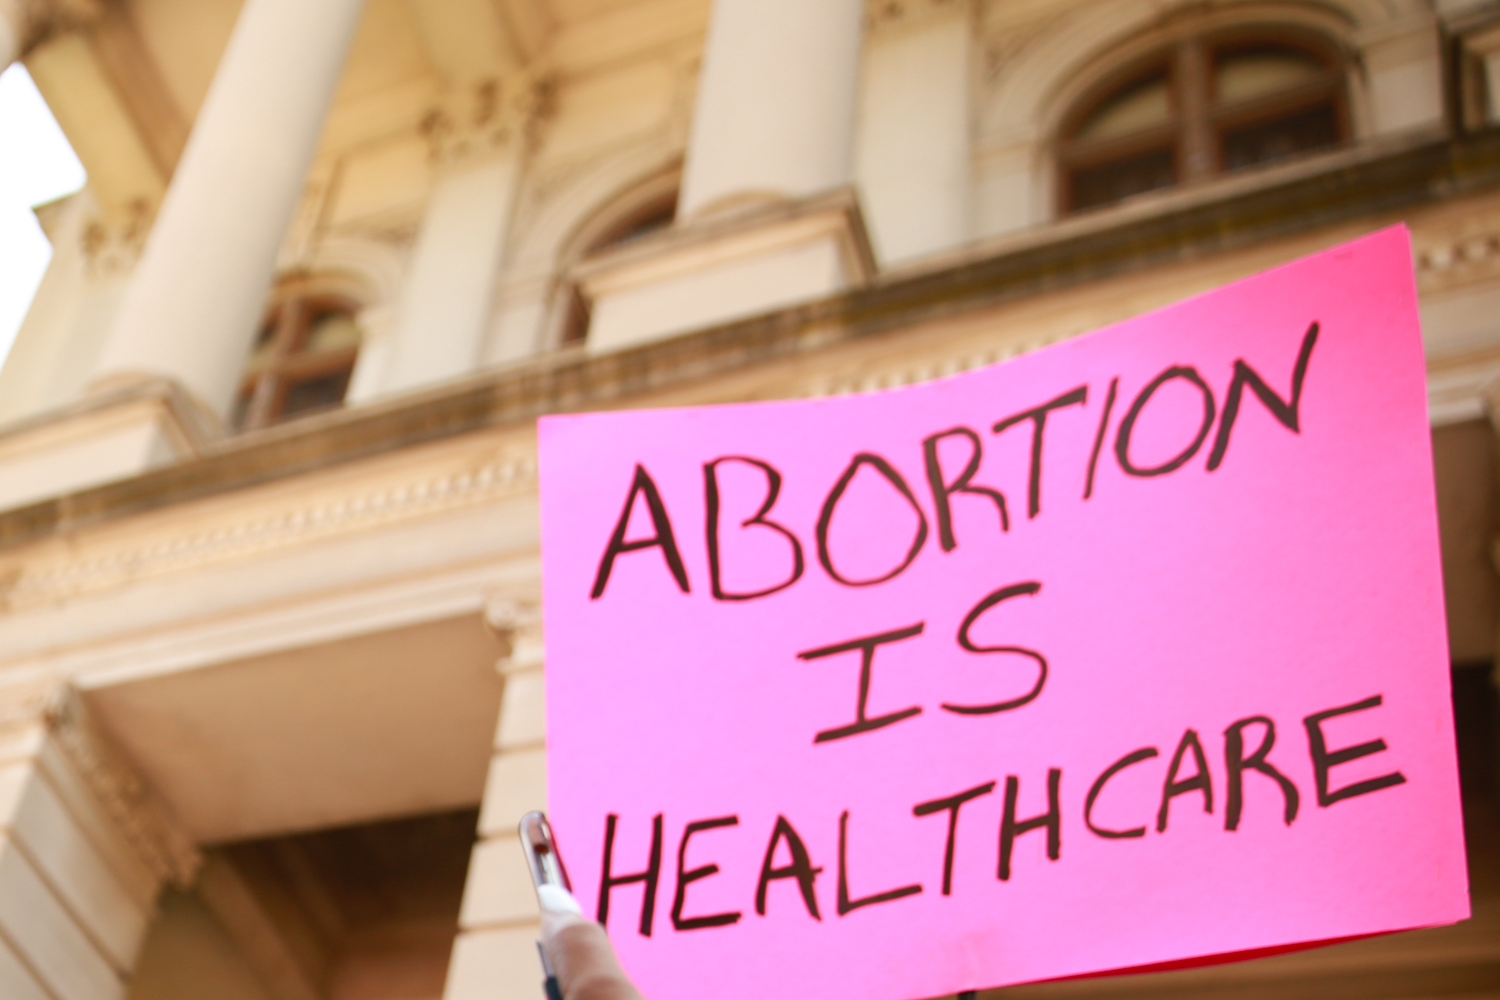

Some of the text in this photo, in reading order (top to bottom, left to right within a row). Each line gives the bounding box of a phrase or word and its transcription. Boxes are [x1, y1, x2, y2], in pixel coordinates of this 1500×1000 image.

[590, 321, 1320, 600] ABORTION
[795, 581, 1049, 745] IS
[595, 694, 1407, 938] HEALTHCARE
